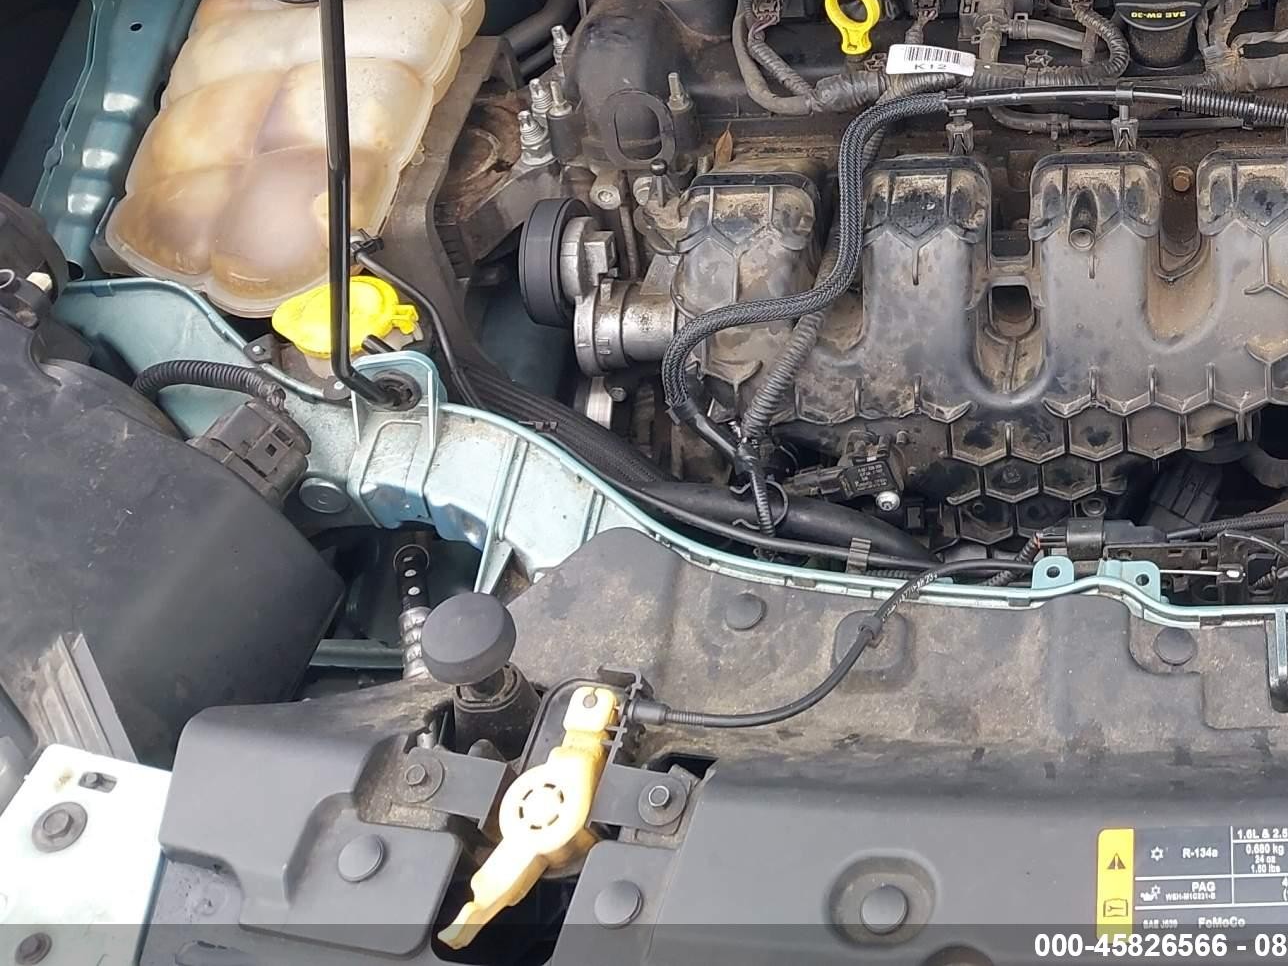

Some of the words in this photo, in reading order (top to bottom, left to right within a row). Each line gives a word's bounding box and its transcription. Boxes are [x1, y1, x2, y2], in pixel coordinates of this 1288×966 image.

[1130, 11, 1163, 19] 5W-30
[1165, 10, 1187, 19] SAE
[914, 62, 947, 71] K12
[1182, 847, 1219, 859] R-134a
[1272, 843, 1285, 856] kg
[1266, 855, 1276, 864] oz
[1268, 863, 1281, 874] lbs
[1191, 881, 1216, 892] PAG
[1198, 916, 1247, 930] FoMoCo
